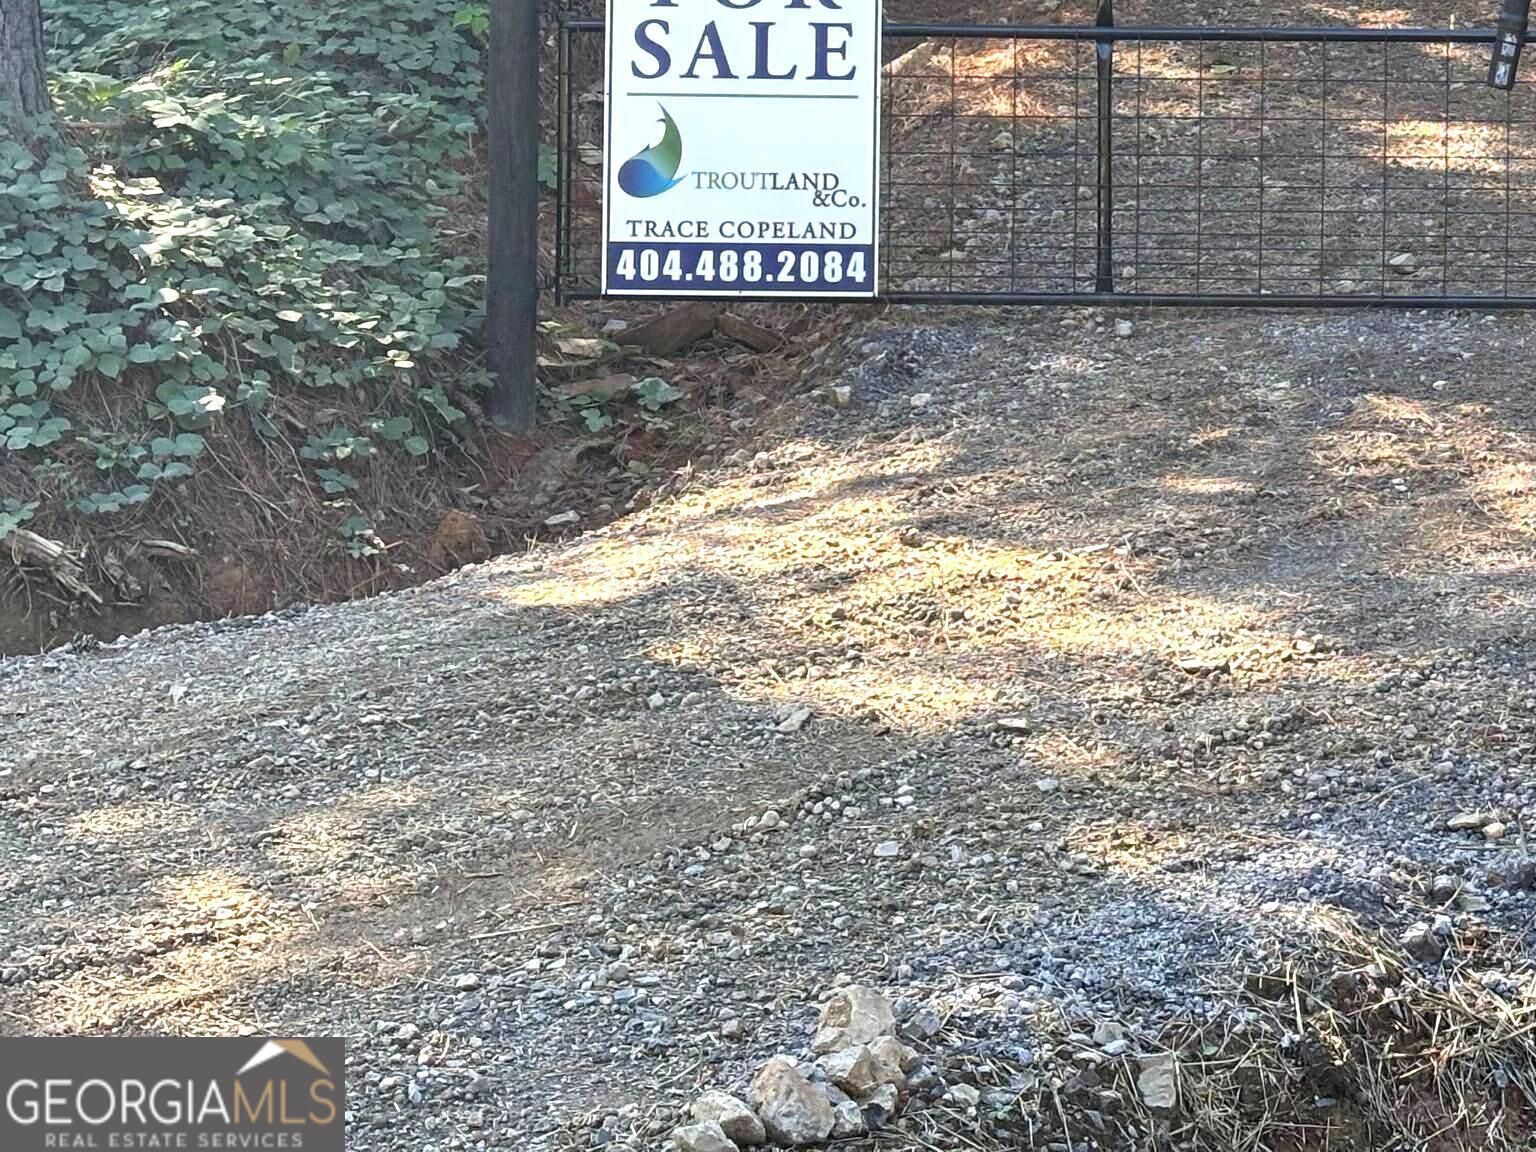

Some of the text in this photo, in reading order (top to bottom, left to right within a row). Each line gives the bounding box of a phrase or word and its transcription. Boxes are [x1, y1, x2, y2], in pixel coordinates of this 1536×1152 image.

[630, 18, 857, 81] SALE
[691, 171, 839, 191] TROUTLAND
[812, 189, 867, 208] &Co.
[626, 219, 857, 240] TRACE COPELAND
[616, 249, 867, 283] 404.488.2084
